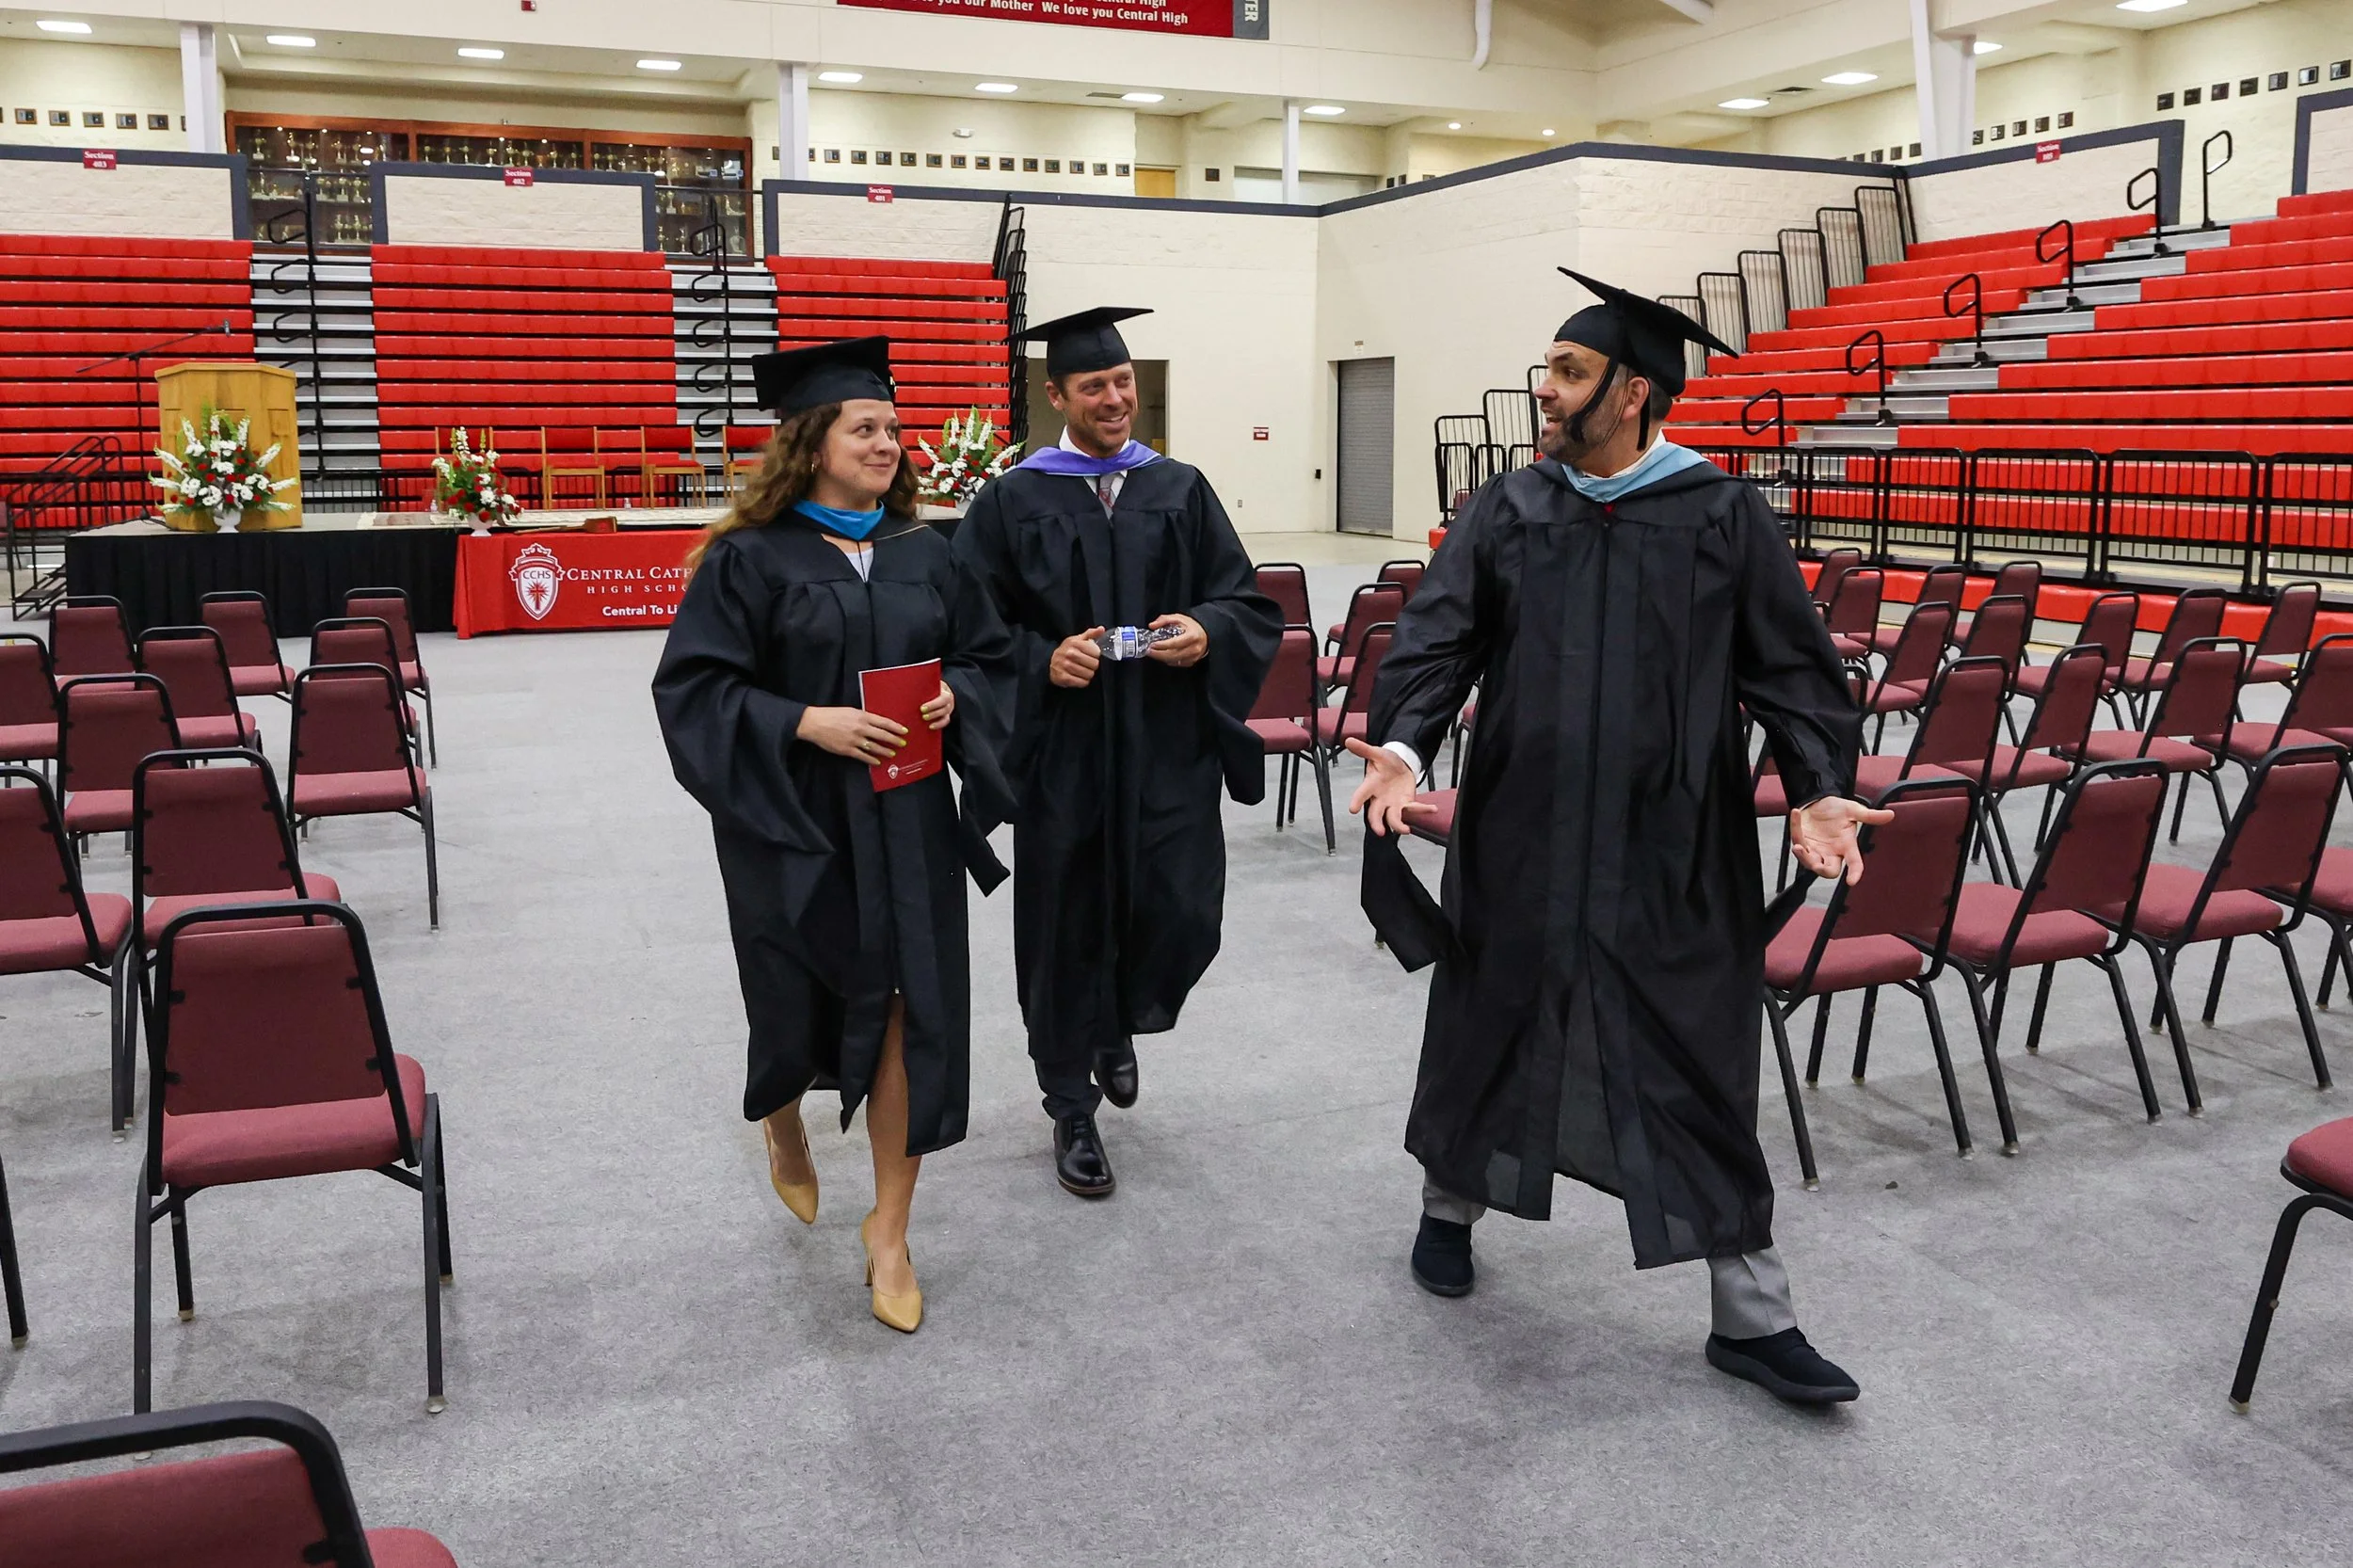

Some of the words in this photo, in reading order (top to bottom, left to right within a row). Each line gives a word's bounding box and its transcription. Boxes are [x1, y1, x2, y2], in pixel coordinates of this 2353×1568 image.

[990, 0, 1034, 11] Mother
[1042, 2, 1060, 13] We
[1064, 4, 1089, 16] love
[1092, 8, 1113, 19] you
[1117, 8, 1159, 22] Central
[1161, 11, 1189, 25] High
[1244, 0, 1259, 22] TER
[85, 151, 114, 159] Section
[522, 570, 552, 580] CCHS
[567, 567, 646, 581] CENTRAL
[648, 566, 693, 581] CATH
[586, 584, 632, 594] HIGH
[644, 584, 688, 593] SCH
[602, 605, 647, 616] Central
[648, 604, 664, 616] To
[666, 603, 678, 615] Li
